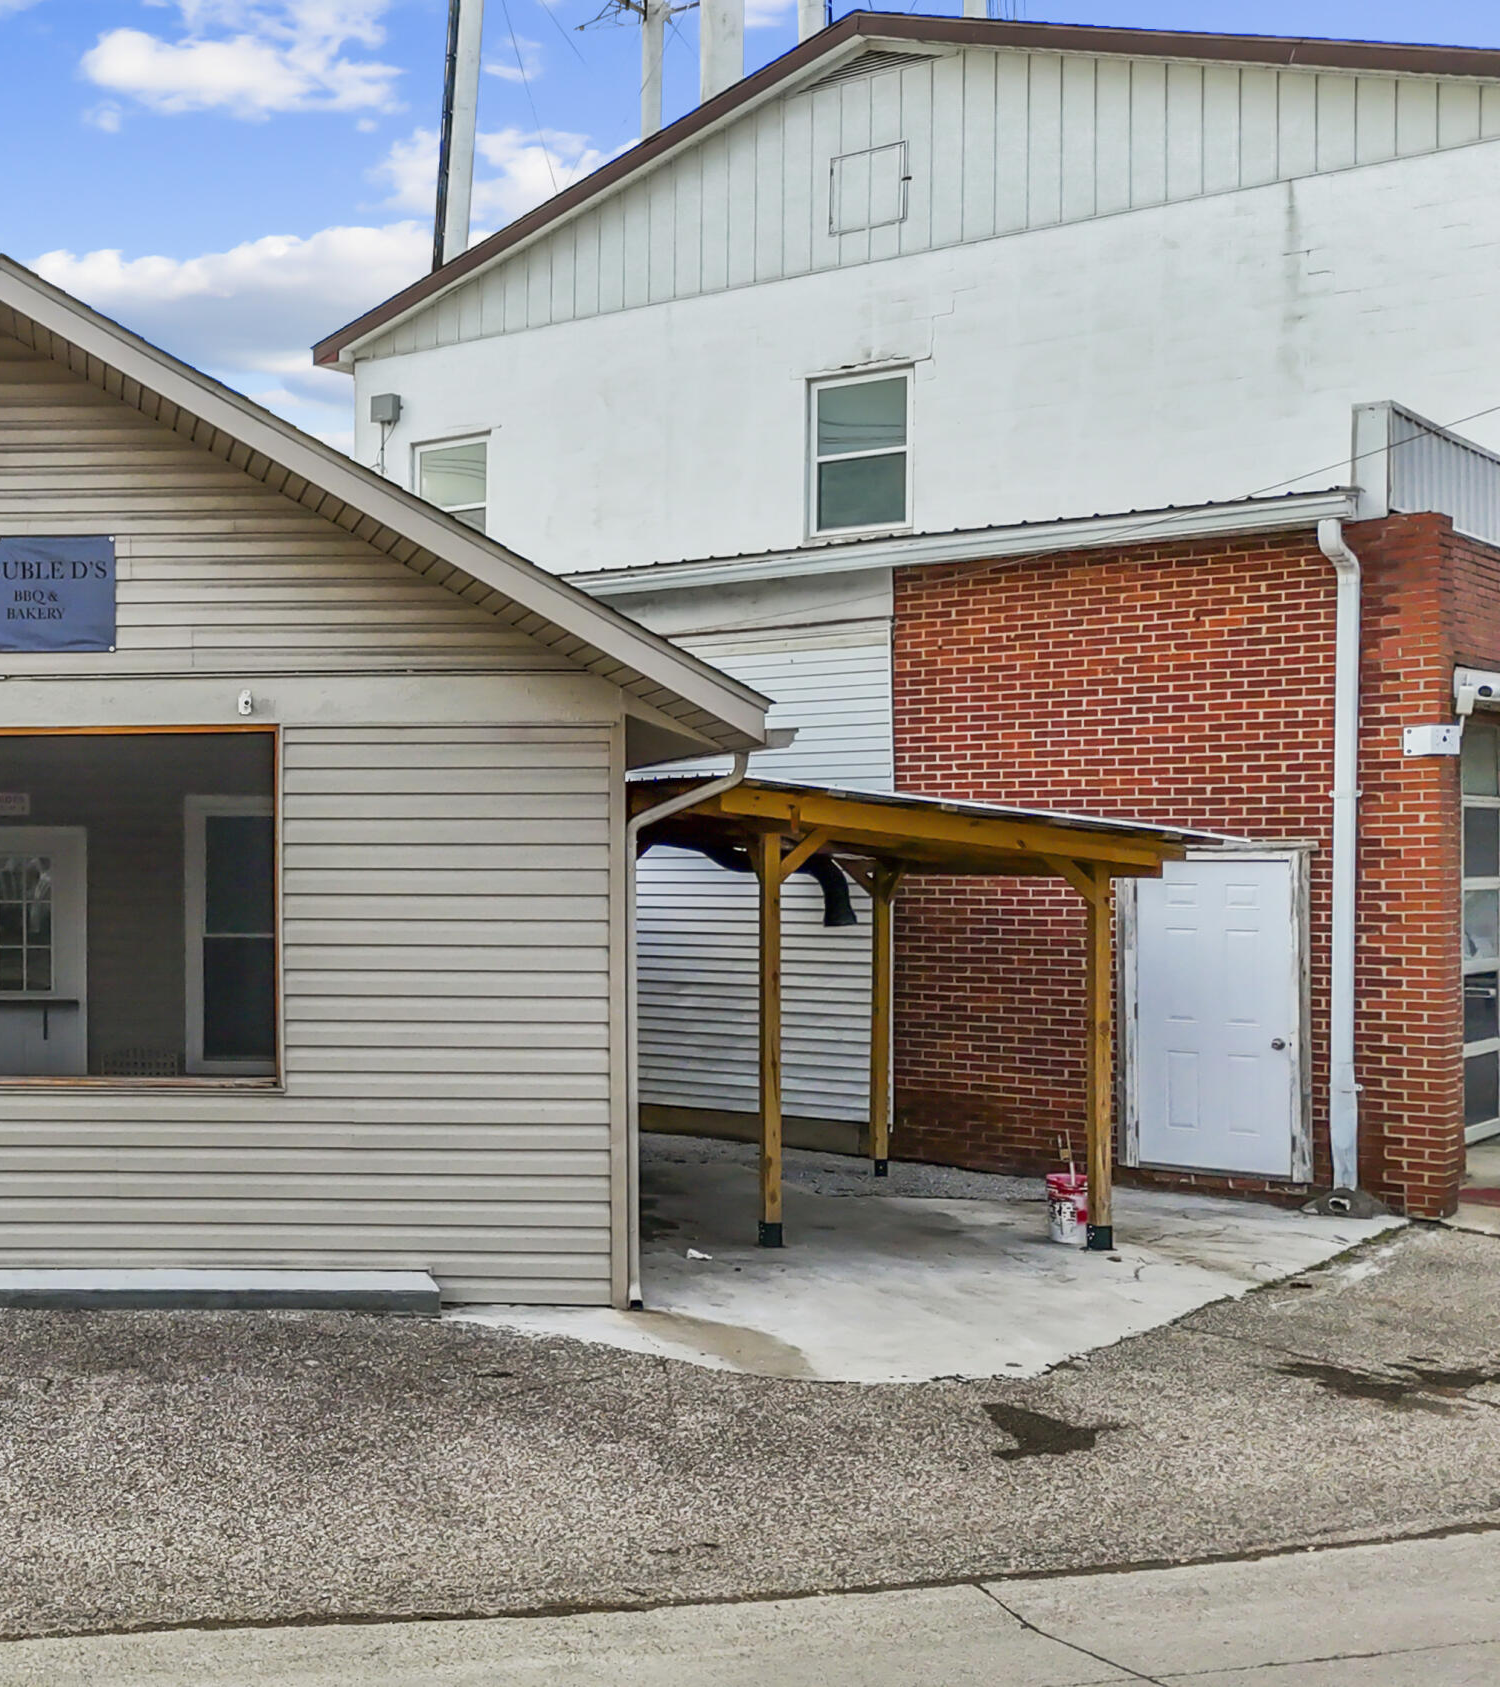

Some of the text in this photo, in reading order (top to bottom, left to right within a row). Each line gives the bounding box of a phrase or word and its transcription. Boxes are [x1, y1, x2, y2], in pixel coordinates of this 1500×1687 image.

[71, 561, 108, 580] D'S
[14, 589, 59, 605] BBQ &
[6, 607, 65, 620] BAKERY
